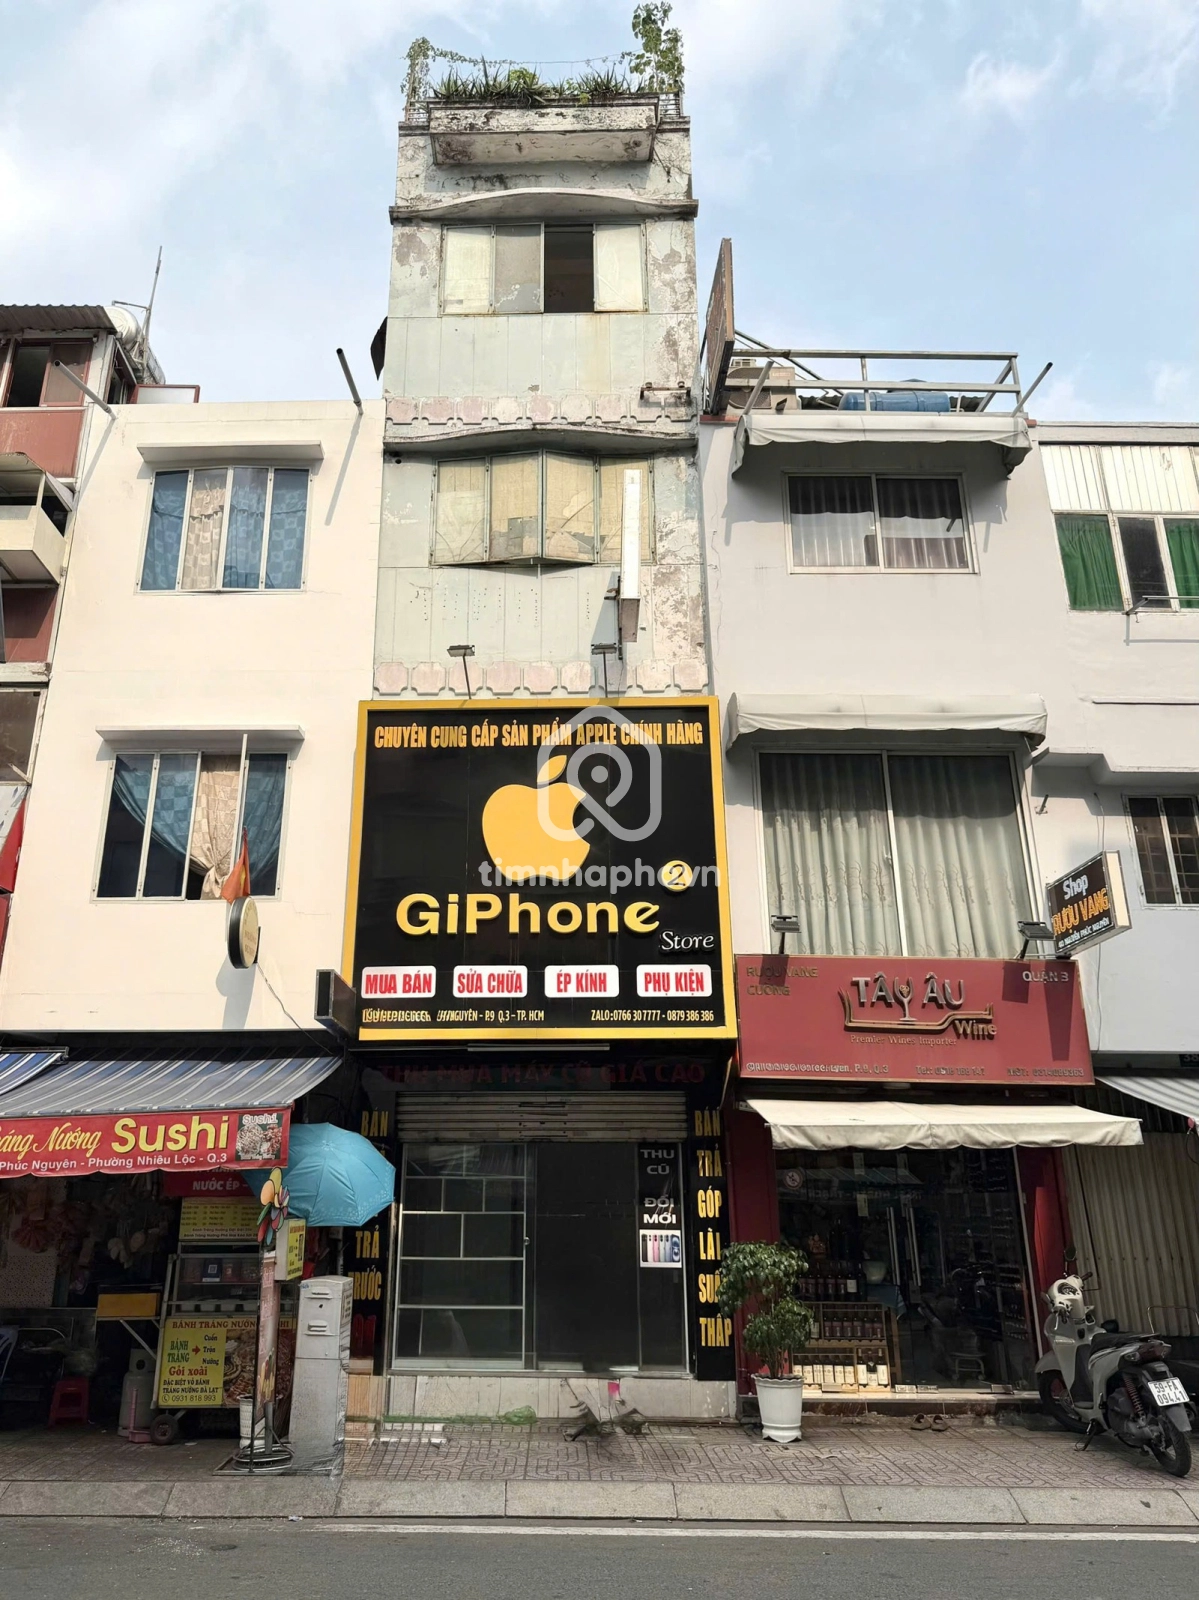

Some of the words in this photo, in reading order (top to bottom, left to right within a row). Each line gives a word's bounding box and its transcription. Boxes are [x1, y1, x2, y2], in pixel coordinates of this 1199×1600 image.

[374, 722, 427, 748] CHUYÊN
[430, 725, 468, 748] CUNG
[471, 719, 499, 747] CẤP
[502, 720, 528, 747] SẢN
[532, 717, 572, 746] PHẨM
[576, 723, 617, 745] APPLE
[621, 720, 663, 745] CHÍNH
[667, 863, 687, 887] 2
[1063, 874, 1089, 900] Shop
[396, 893, 660, 935] GiPhone
[1079, 887, 1109, 921] VANG
[661, 931, 715, 950] Store
[365, 974, 397, 994] MUA
[402, 970, 432, 993] BÁN
[457, 968, 483, 993] SỬA
[487, 970, 523, 993] CHỮA
[556, 969, 572, 992] ÉP
[576, 969, 607, 992] KÍNH
[644, 972, 670, 996] PHỤ
[675, 968, 704, 996] KIỆN
[852, 971, 917, 1020] TÂY
[923, 971, 965, 1006] ÂU
[485, 1010, 494, 1021] P.9
[498, 1010, 510, 1023] Q.3
[529, 1010, 545, 1021] HCM
[955, 1020, 998, 1036] Wine
[851, 1034, 885, 1045] Premier
[889, 1035, 917, 1045] Wines
[919, 1037, 958, 1047] Importer
[655, 1064, 705, 1083] CAO
[242, 1113, 279, 1124] Sushi
[360, 1107, 389, 1137] BÁN
[32, 1122, 101, 1157] Nướng
[111, 1116, 229, 1153] Sushi
[0, 1160, 28, 1170] Phúc
[32, 1159, 77, 1171] Nguyên
[88, 1155, 133, 1168] Phường
[137, 1154, 171, 1165] Nhiêu
[174, 1155, 196, 1166] Lộc
[207, 1152, 227, 1163] Q.3
[640, 1149, 675, 1159] THU
[697, 1143, 723, 1177] TRẢ
[646, 1163, 670, 1175] CŨ
[192, 1178, 224, 1190] NƯỚC
[226, 1178, 240, 1190] ÉP
[697, 1185, 722, 1218] GÓP
[643, 1211, 677, 1224] MỚI
[355, 1226, 380, 1259] TRẢ
[698, 1270, 721, 1304] SU
[172, 1319, 199, 1329] BÁNH
[200, 1319, 229, 1329] TRÁNG
[231, 1318, 256, 1328] NƯỚN
[170, 1338, 189, 1351] BÁNH
[167, 1351, 190, 1363] TRÁNG
[1154, 1381, 1179, 1393] 59-FA
